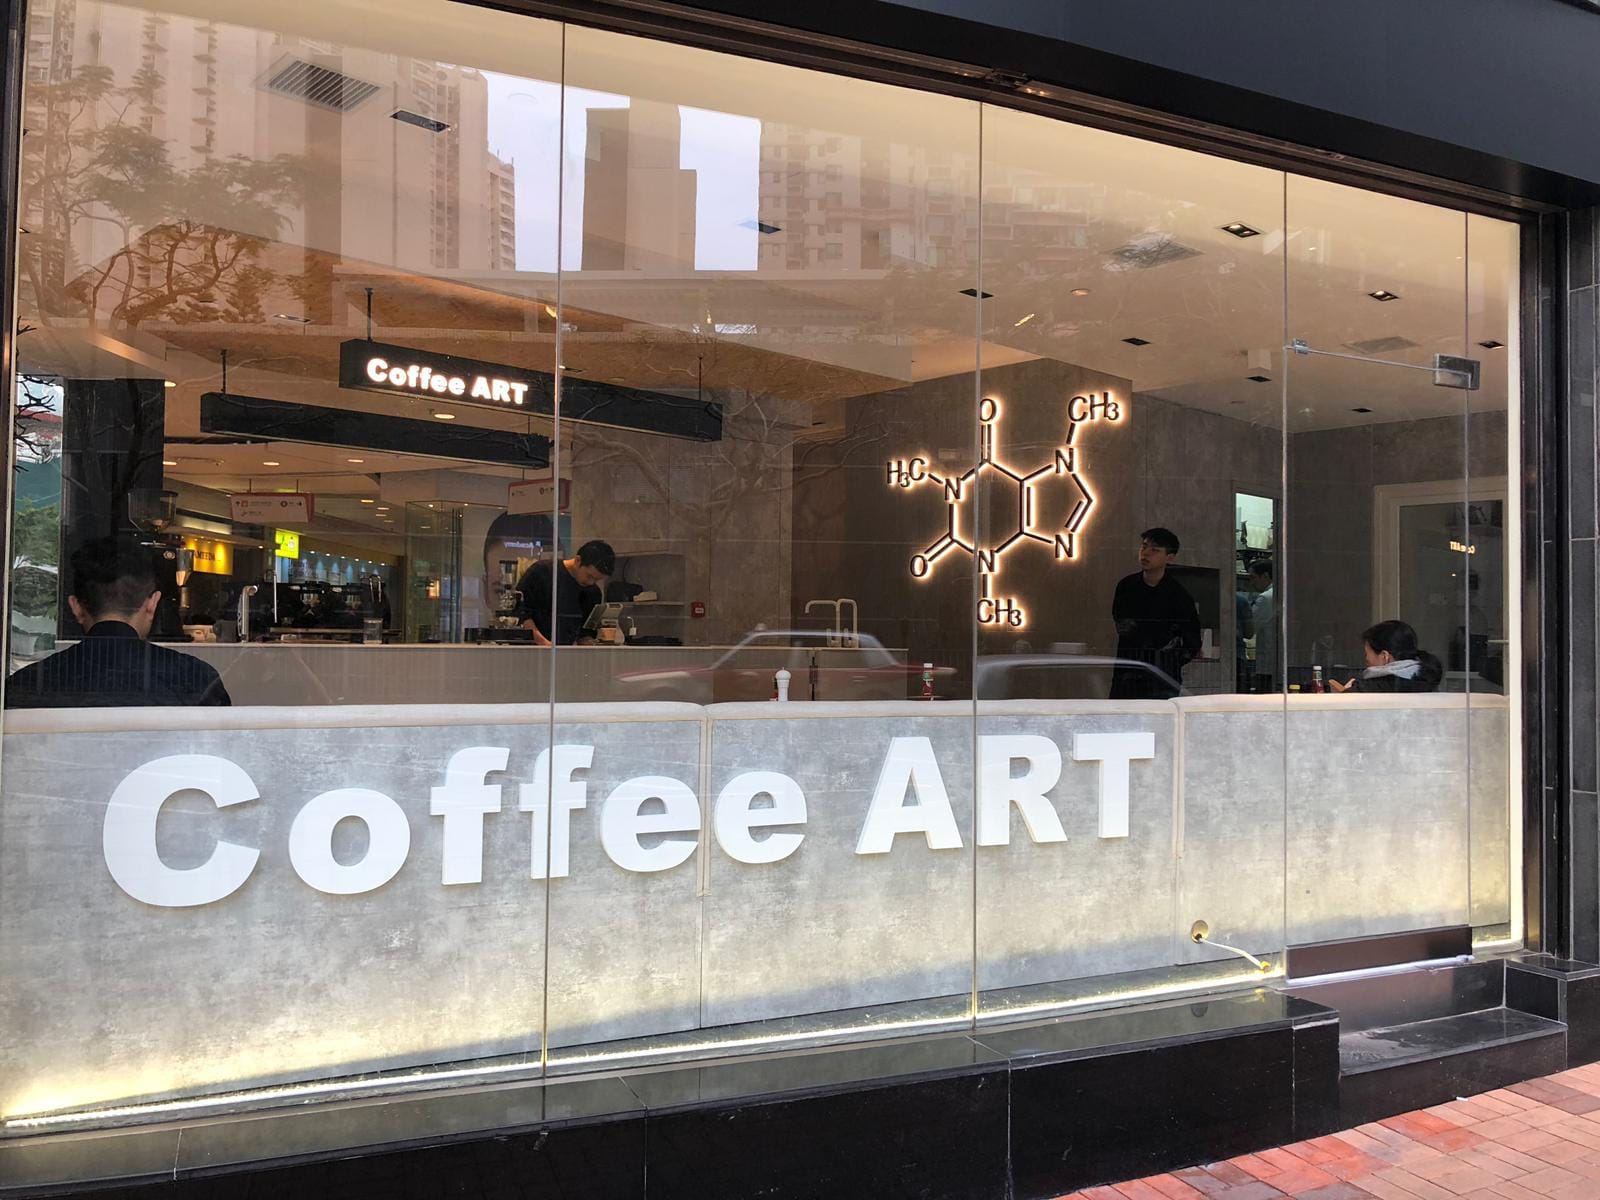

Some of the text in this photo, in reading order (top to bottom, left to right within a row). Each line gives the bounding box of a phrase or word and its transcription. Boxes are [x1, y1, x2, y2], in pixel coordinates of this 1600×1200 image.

[366, 358, 529, 404] Coffee ART
[1067, 391, 1120, 422] CH3
[886, 457, 926, 488] H3C
[1055, 447, 1074, 474] N
[944, 477, 961, 501] N
[1055, 533, 1074, 559] N
[978, 550, 995, 573] N
[976, 599, 1022, 627] CH3
[102, 732, 1155, 907] Coffee ART
